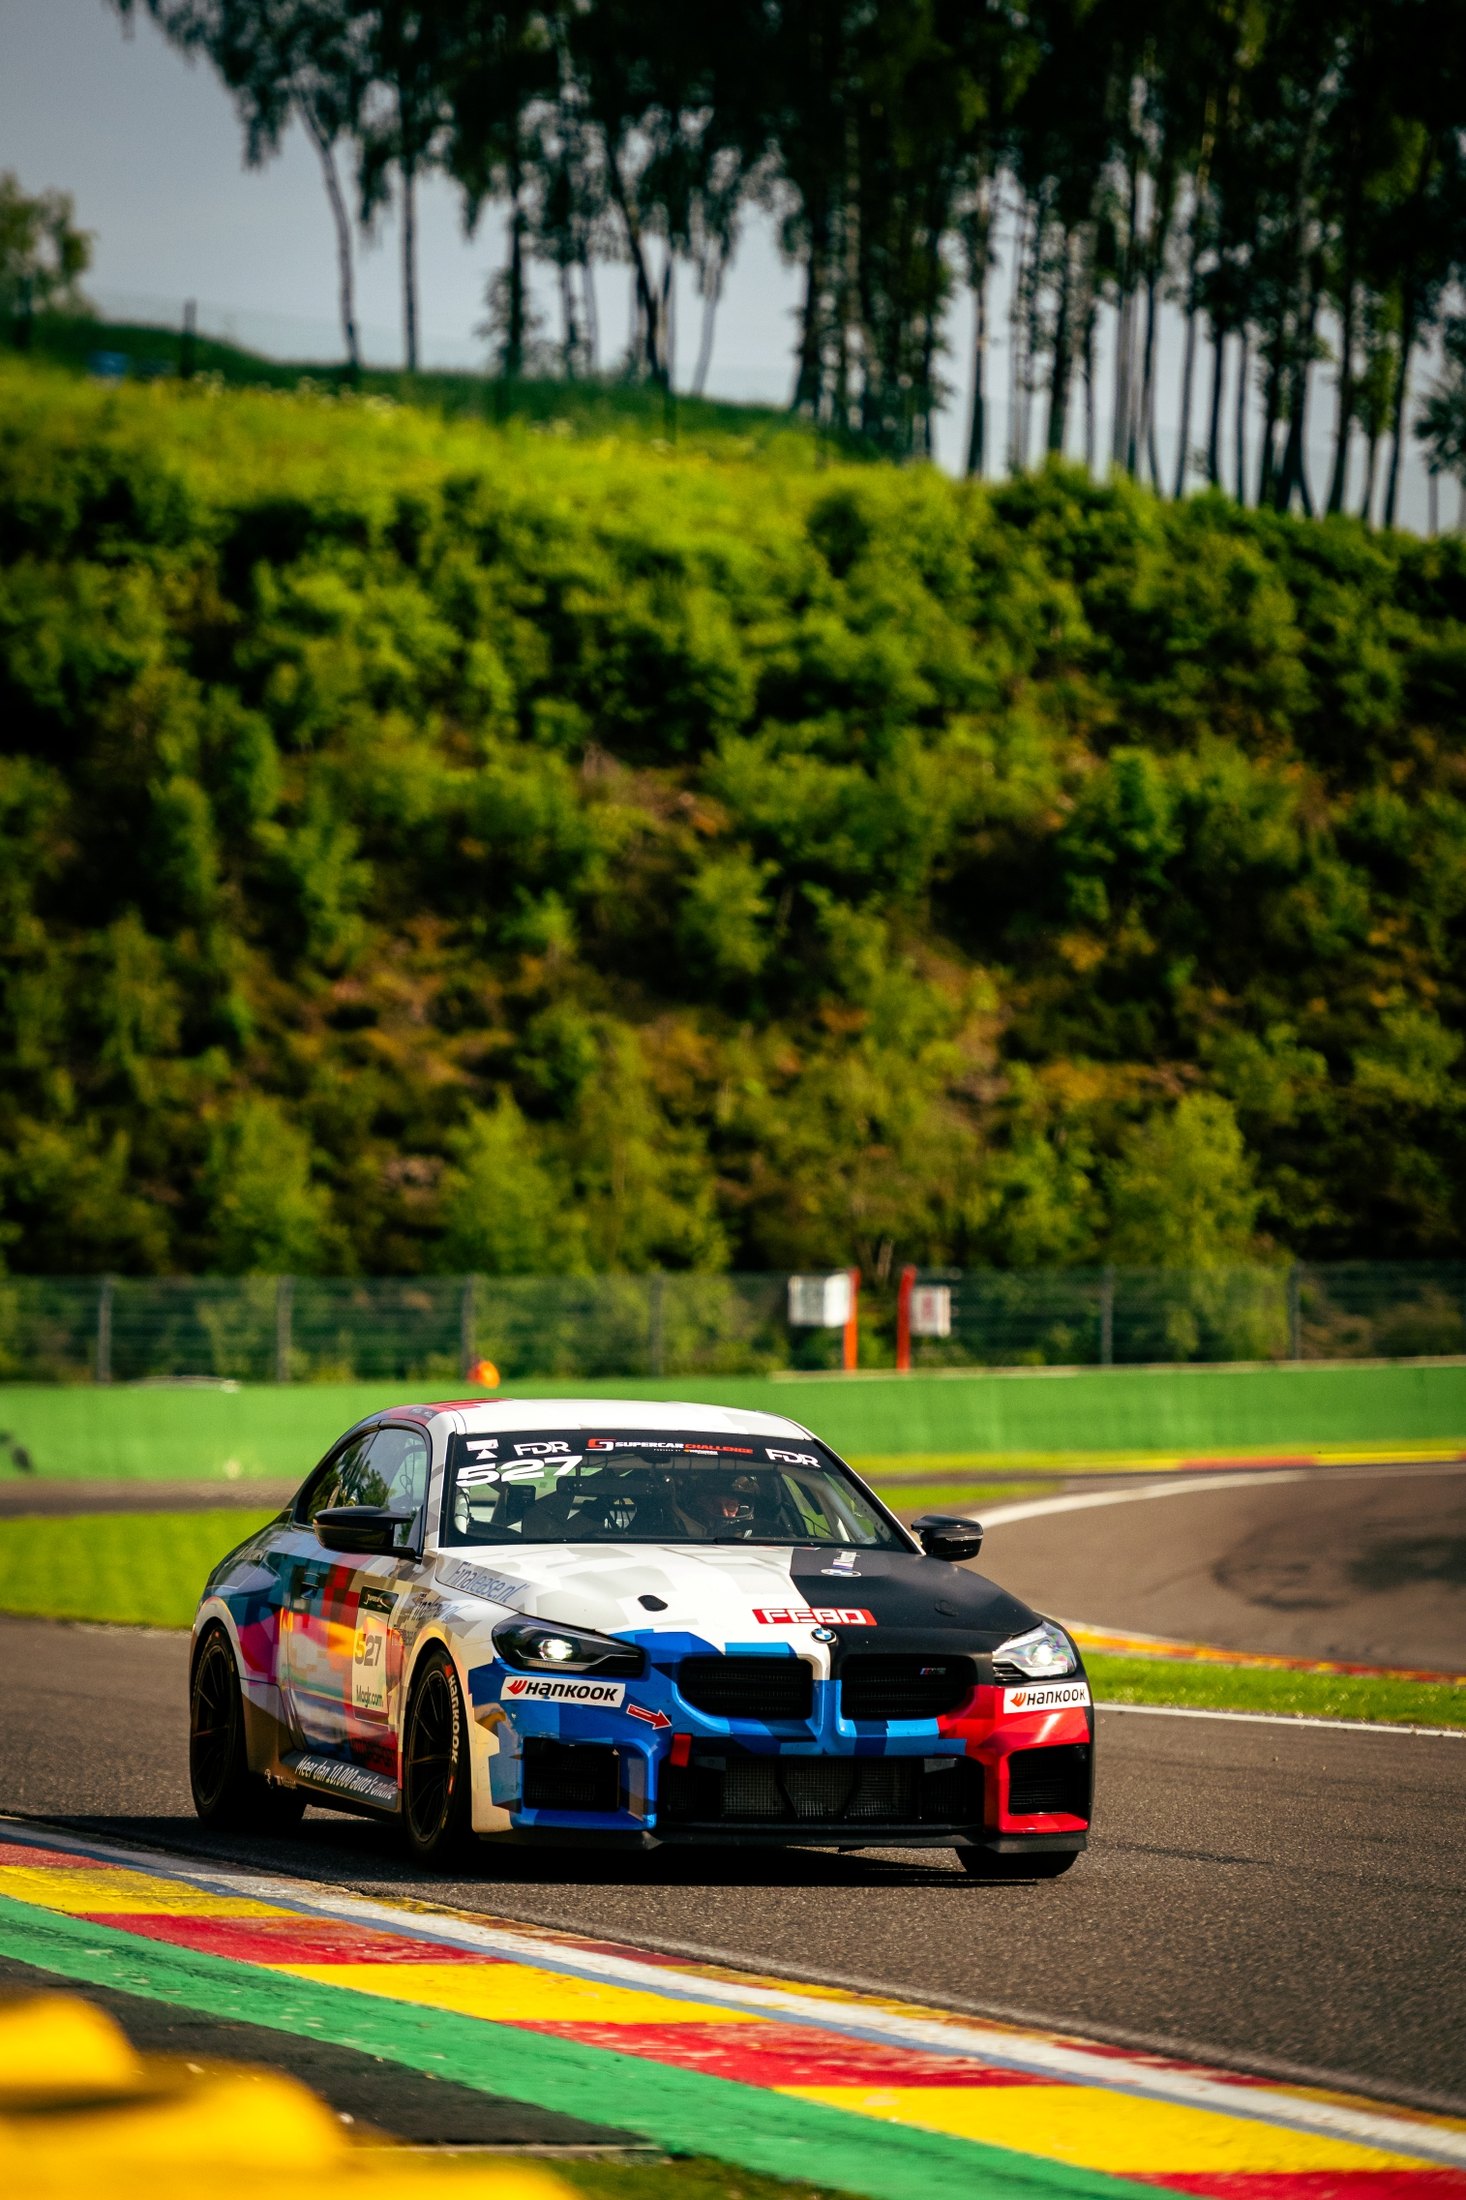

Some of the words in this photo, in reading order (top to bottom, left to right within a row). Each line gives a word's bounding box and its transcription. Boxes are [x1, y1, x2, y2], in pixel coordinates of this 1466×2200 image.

[513, 1441, 571, 1456] FDR
[765, 1448, 821, 1468] FDR
[455, 1455, 583, 1487] 527
[761, 1609, 866, 1624] FEBO
[354, 1633, 382, 1667] 527
